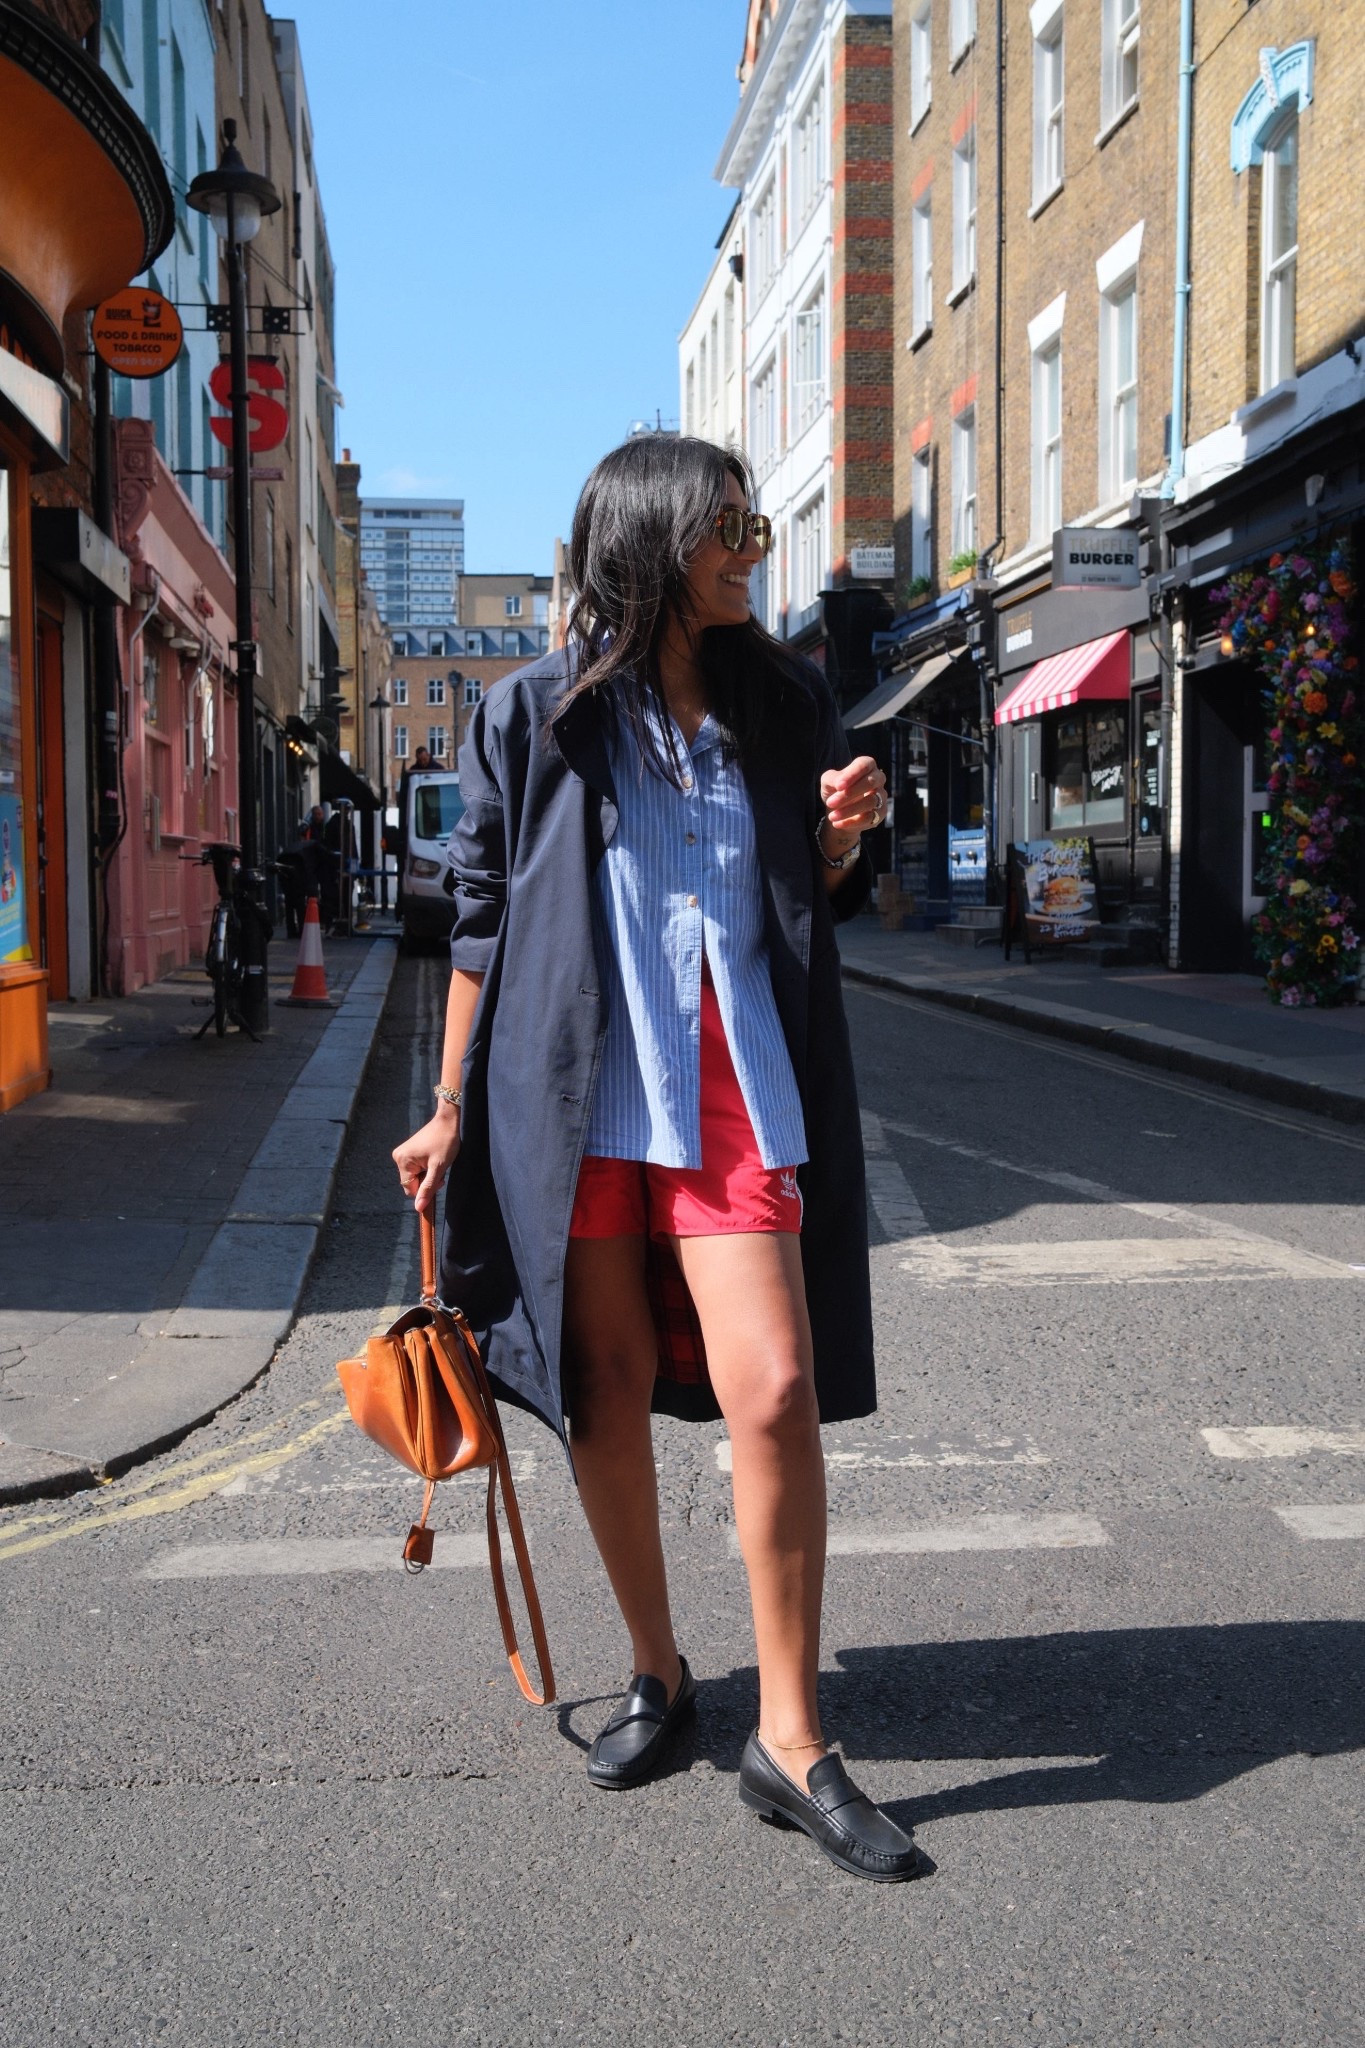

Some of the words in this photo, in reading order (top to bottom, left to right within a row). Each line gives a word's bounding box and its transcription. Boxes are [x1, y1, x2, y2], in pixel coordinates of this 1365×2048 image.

[97, 330, 129, 339] FOOD
[131, 331, 138, 340] &
[141, 331, 177, 342] DRINKS
[113, 343, 162, 353] TOBACCO
[208, 358, 288, 453] S
[1070, 537, 1135, 552] TRUFFLE
[1069, 552, 1135, 566] BURGER
